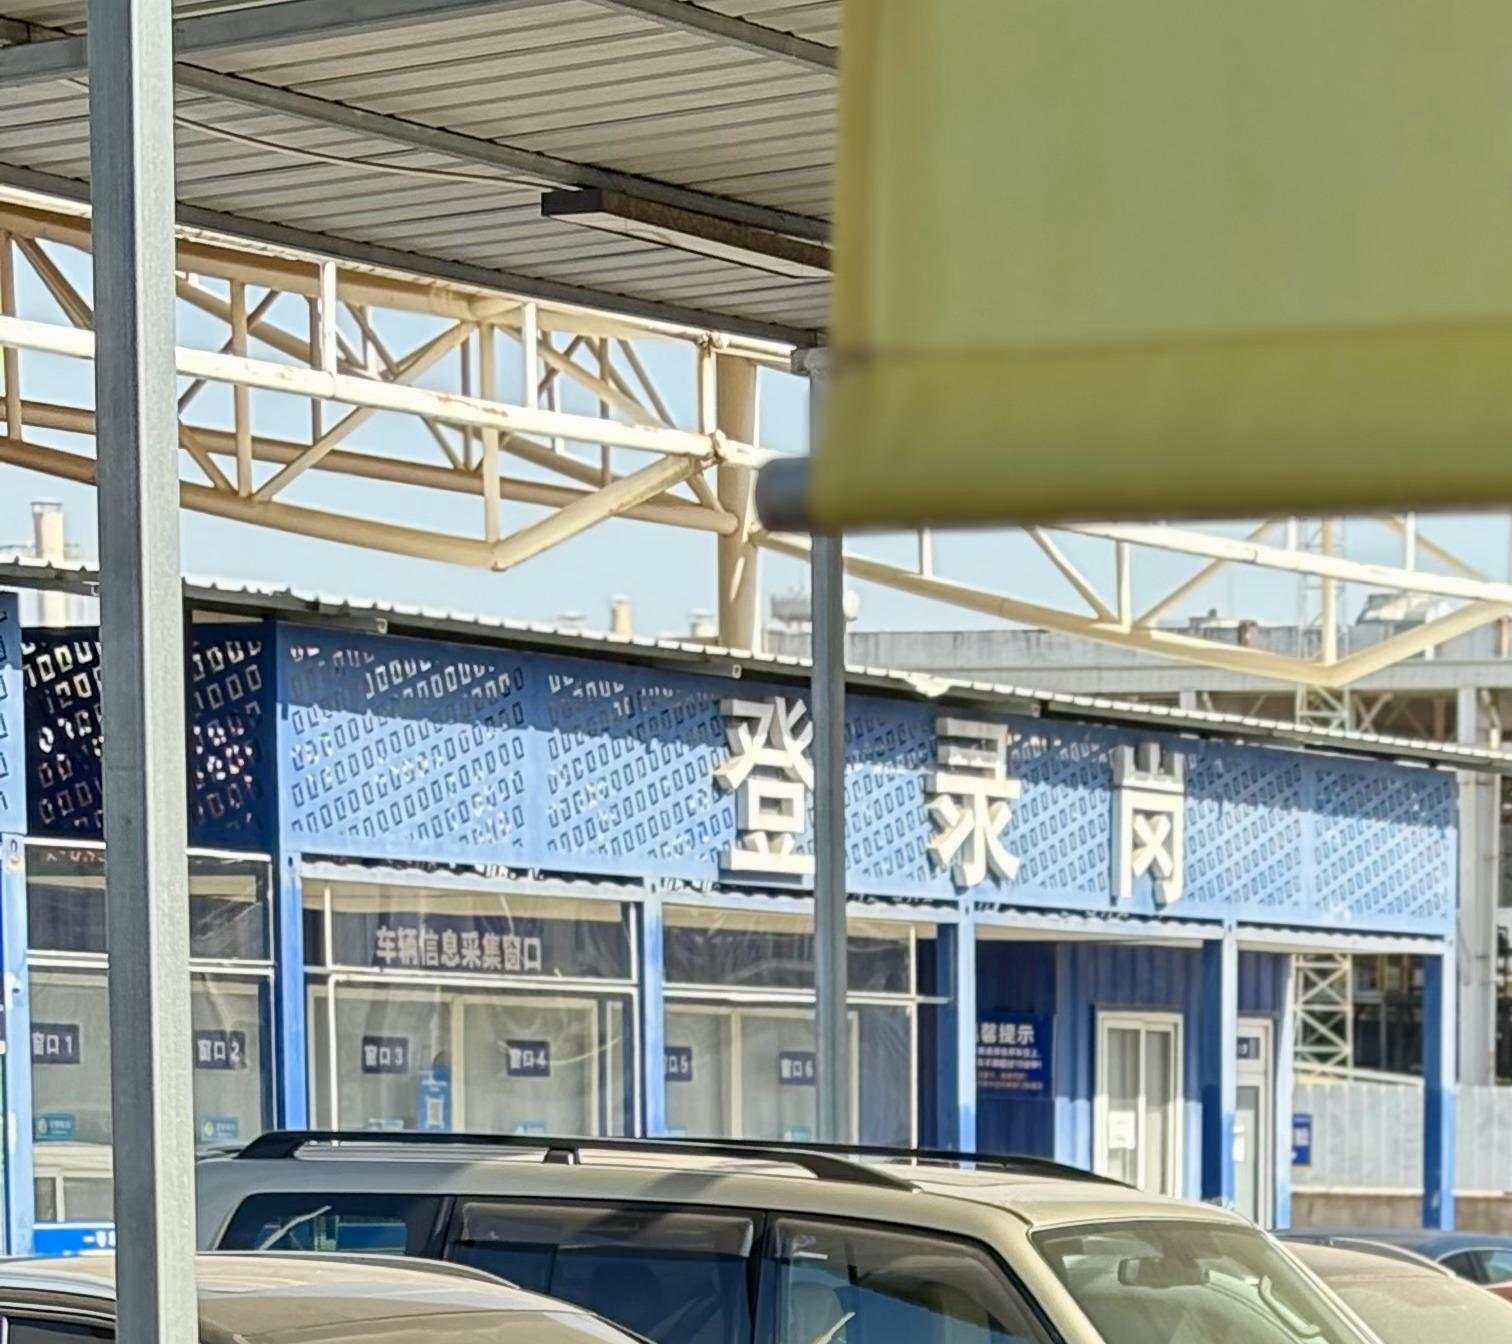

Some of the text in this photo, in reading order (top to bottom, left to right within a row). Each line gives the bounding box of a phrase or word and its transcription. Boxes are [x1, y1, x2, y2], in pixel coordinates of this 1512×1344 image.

[376, 925, 543, 971] 车辆信息采集窗口
[976, 1022, 1035, 1045] 馨提示
[664, 1056, 689, 1074] 口5
